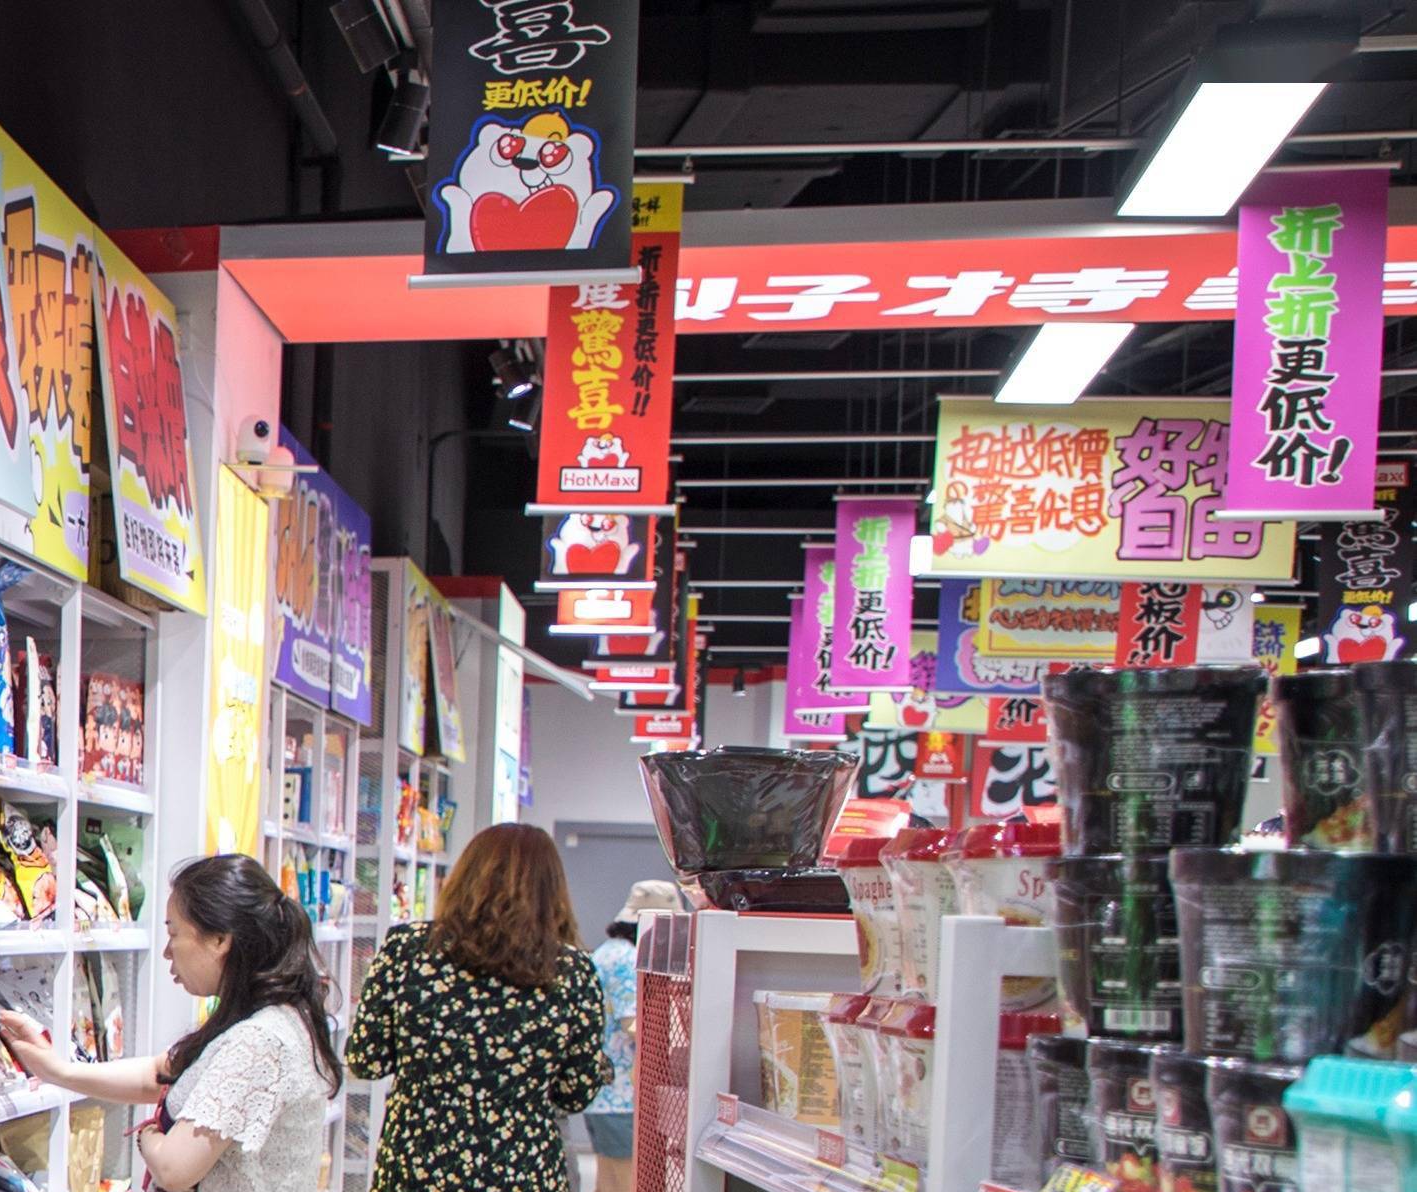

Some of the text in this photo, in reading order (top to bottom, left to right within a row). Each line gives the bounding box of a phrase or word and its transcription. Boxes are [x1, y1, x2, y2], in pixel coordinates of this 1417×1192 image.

[483, 79, 593, 111] 更低价!
[1254, 203, 1352, 487] 折上折更低价!
[946, 427, 1111, 482] 超越低價
